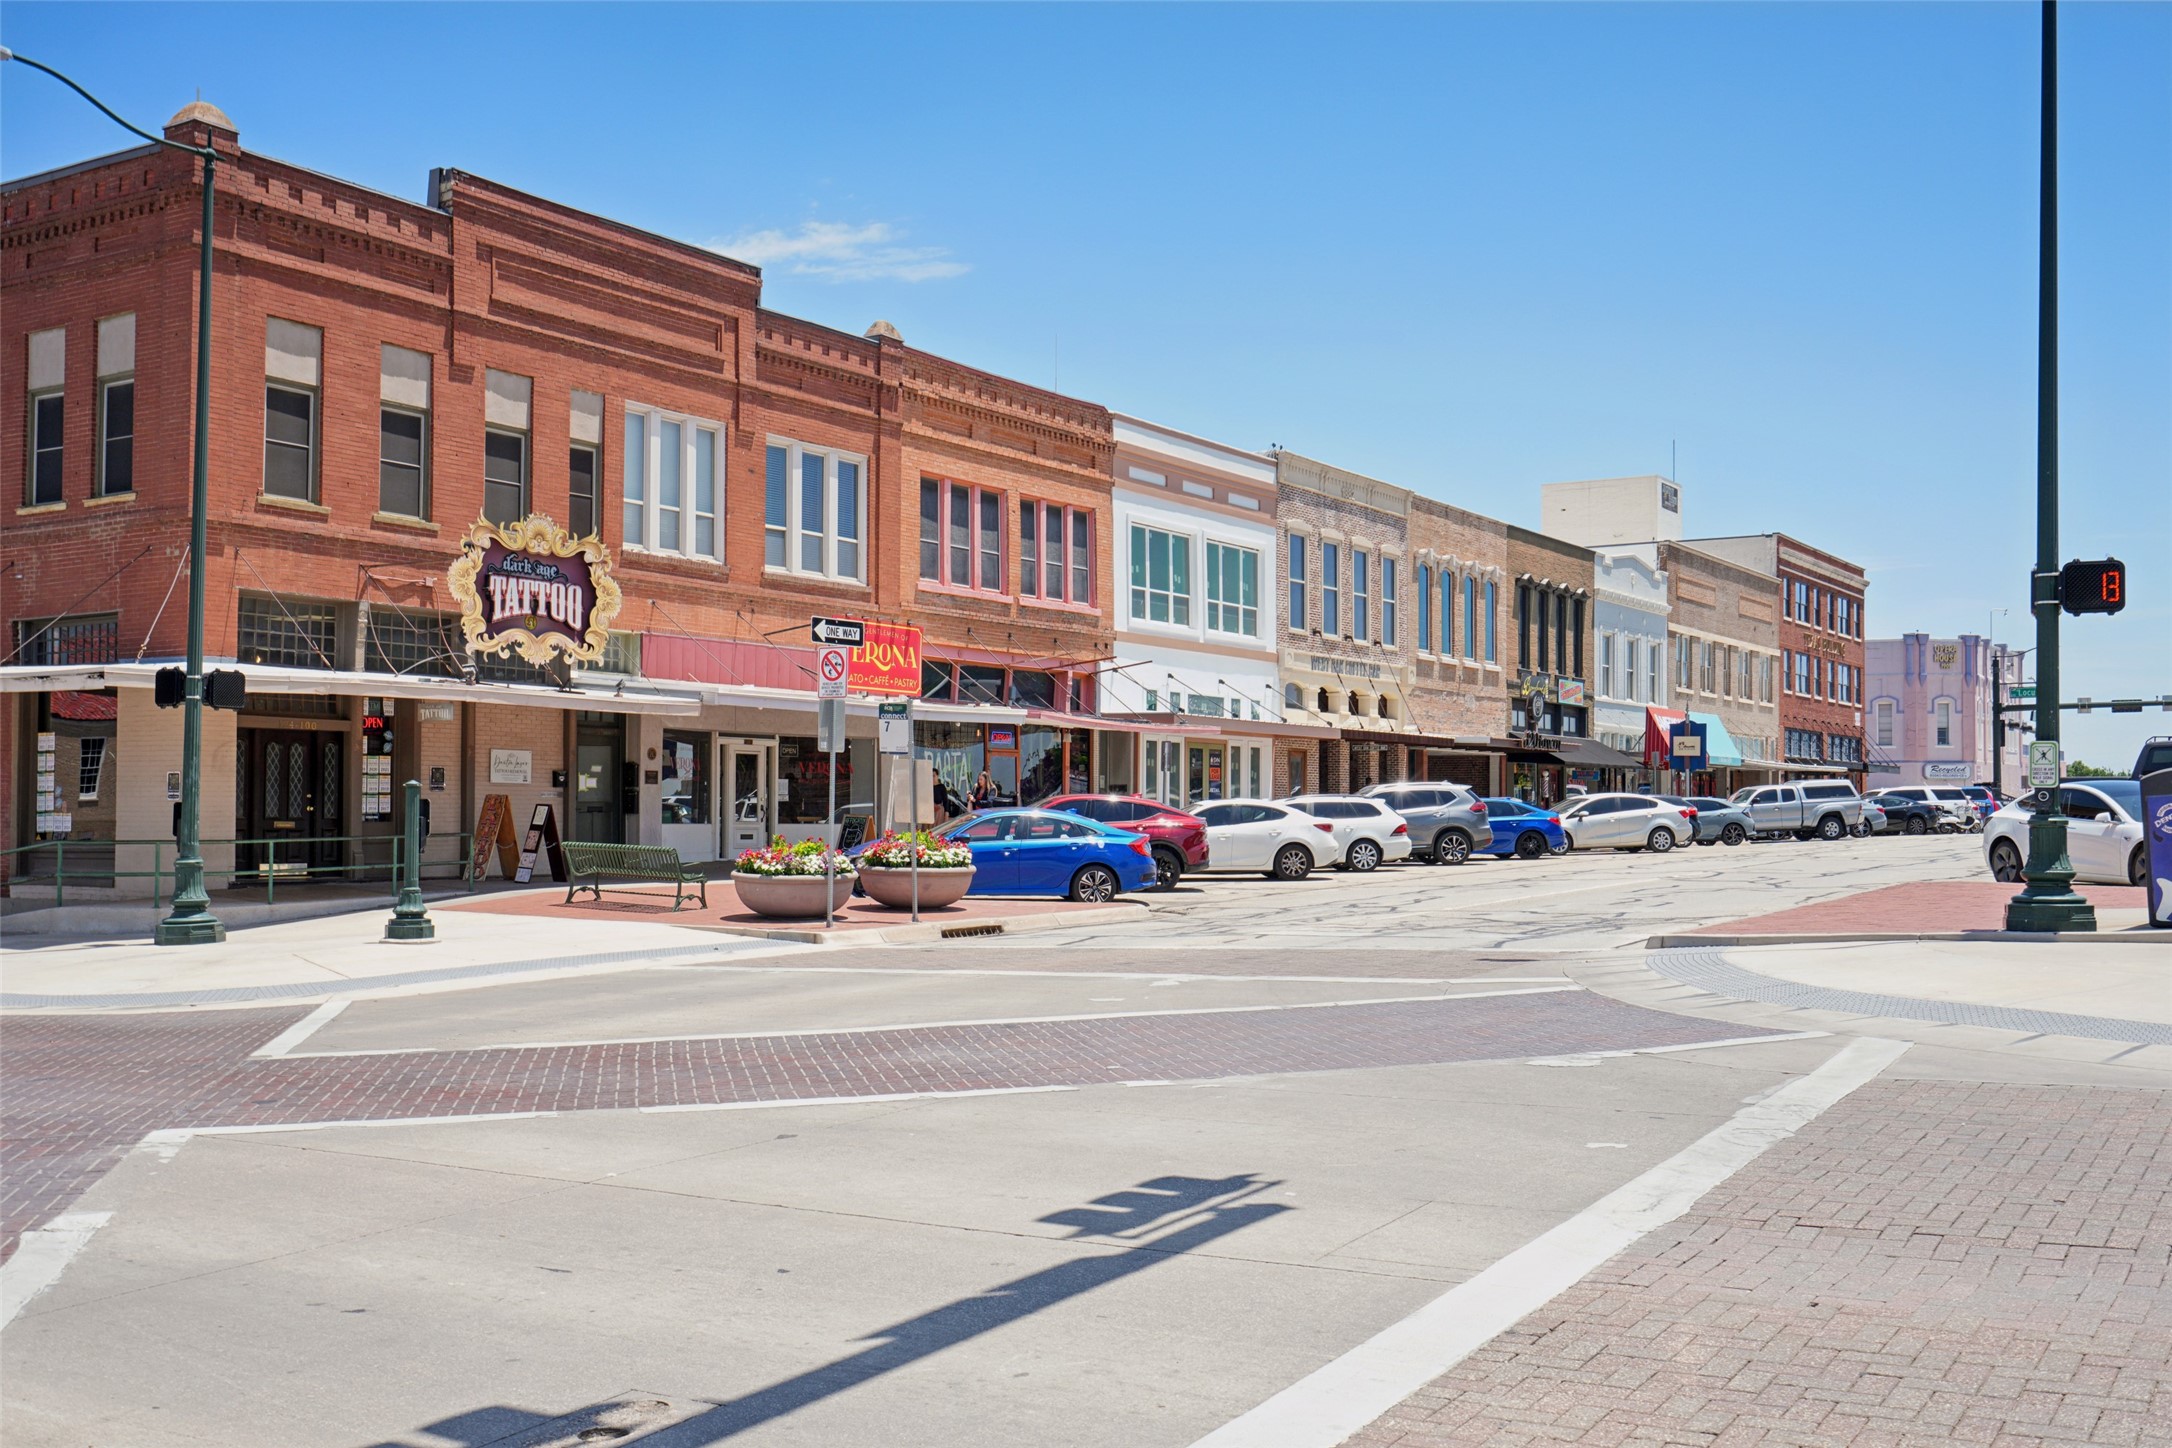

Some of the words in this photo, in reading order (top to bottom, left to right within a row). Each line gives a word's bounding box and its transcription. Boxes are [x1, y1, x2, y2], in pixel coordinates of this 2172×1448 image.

[502, 553, 532, 573] dark
[534, 561, 558, 580] age
[2102, 571, 2120, 602] 13
[489, 574, 583, 631] TATTOO
[825, 626, 840, 637] ONE
[842, 628, 858, 639] WAY
[1933, 644, 1957, 653] OPERA
[852, 640, 918, 671] ERONA
[1933, 653, 1957, 662] HOUSE
[1311, 655, 1329, 672] WEST
[1345, 660, 1367, 678] COFFEE
[894, 677, 918, 689] PASTRY
[362, 717, 383, 728] OPEN
[884, 721, 891, 732] 7
[1931, 764, 1967, 773] Recycled
